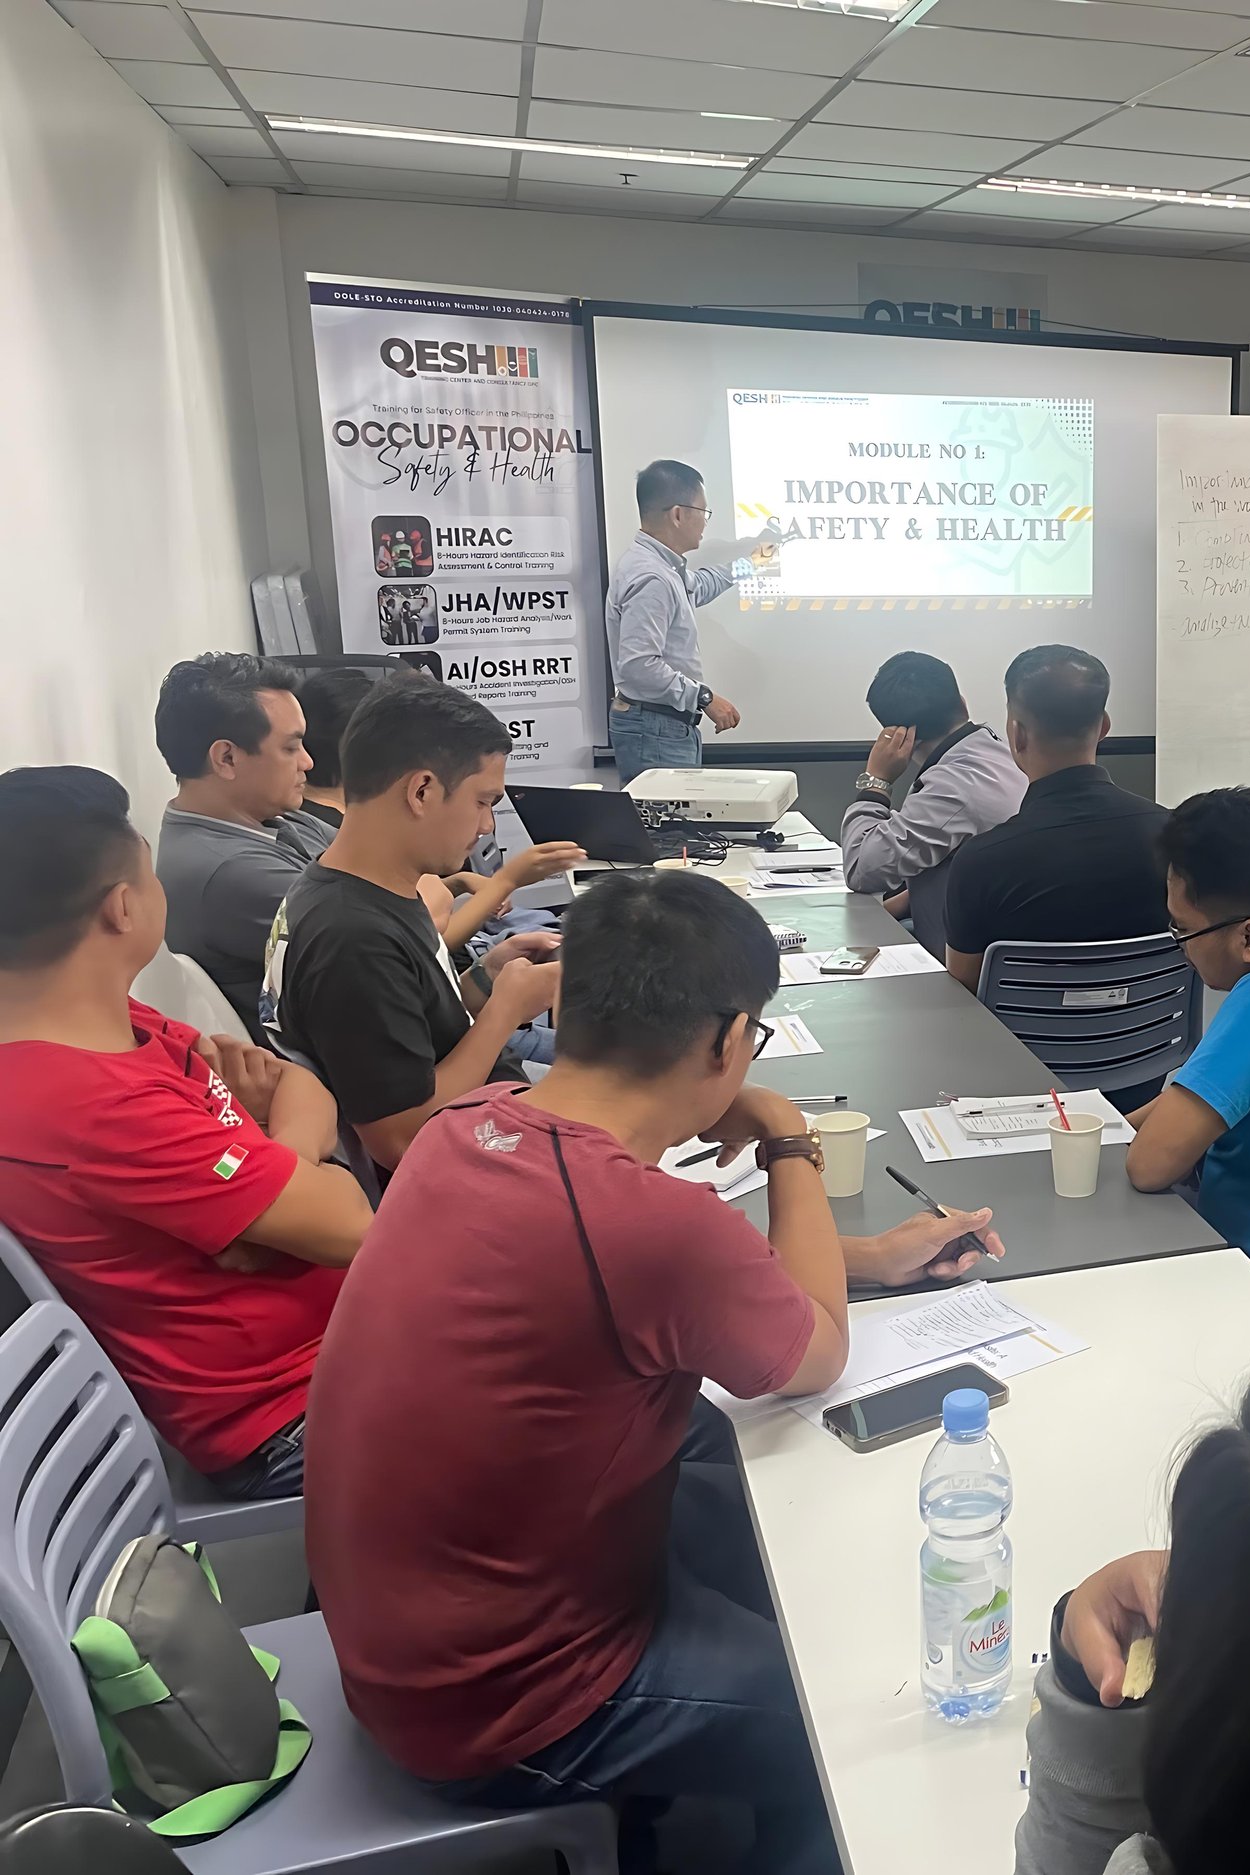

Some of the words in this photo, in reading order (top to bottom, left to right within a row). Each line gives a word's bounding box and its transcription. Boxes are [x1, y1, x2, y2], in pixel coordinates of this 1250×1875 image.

[333, 292, 383, 302] DOLE-STO
[386, 296, 451, 308] Accreditation
[454, 302, 489, 311] Number
[379, 337, 497, 378] QESH
[732, 393, 768, 405] QESH
[372, 404, 408, 414] Training
[410, 405, 422, 414] for
[425, 406, 452, 416] Safety
[455, 407, 483, 416] Officer
[485, 408, 493, 417] in
[495, 409, 509, 418] the
[511, 411, 555, 420] Philippines
[332, 419, 592, 454] OCCUPATIONAL
[848, 442, 932, 459] MODULE
[939, 443, 967, 459] NO
[974, 444, 985, 460] 1:
[377, 445, 456, 496] Safety
[463, 445, 482, 482] &
[489, 446, 554, 485] Health
[784, 479, 997, 507] IMPORTANCE
[1009, 482, 1049, 507] OF
[436, 527, 513, 547] HIRAC
[765, 516, 890, 541] SAFETY
[904, 517, 923, 541] &
[936, 517, 1067, 542] HEALTH
[470, 551, 499, 559] Hazard
[550, 550, 565, 558] Risk
[438, 561, 486, 570] Assessment
[494, 561, 523, 569] Control
[524, 561, 554, 570] Training
[1177, 559, 1192, 573] 2.
[441, 586, 569, 616] JHA/WPST
[475, 616, 490, 624] Job
[491, 615, 518, 623] Hazard
[443, 627, 469, 635] Permit
[470, 626, 499, 635] System
[500, 626, 531, 634] Training
[447, 655, 527, 683] AI/OSH
[532, 657, 572, 675] RRT
[479, 681, 511, 689] Accident
[478, 692, 506, 700] Reports
[508, 690, 537, 698] Training
[501, 719, 535, 739] ST
[992, 1619, 1005, 1635] Le
